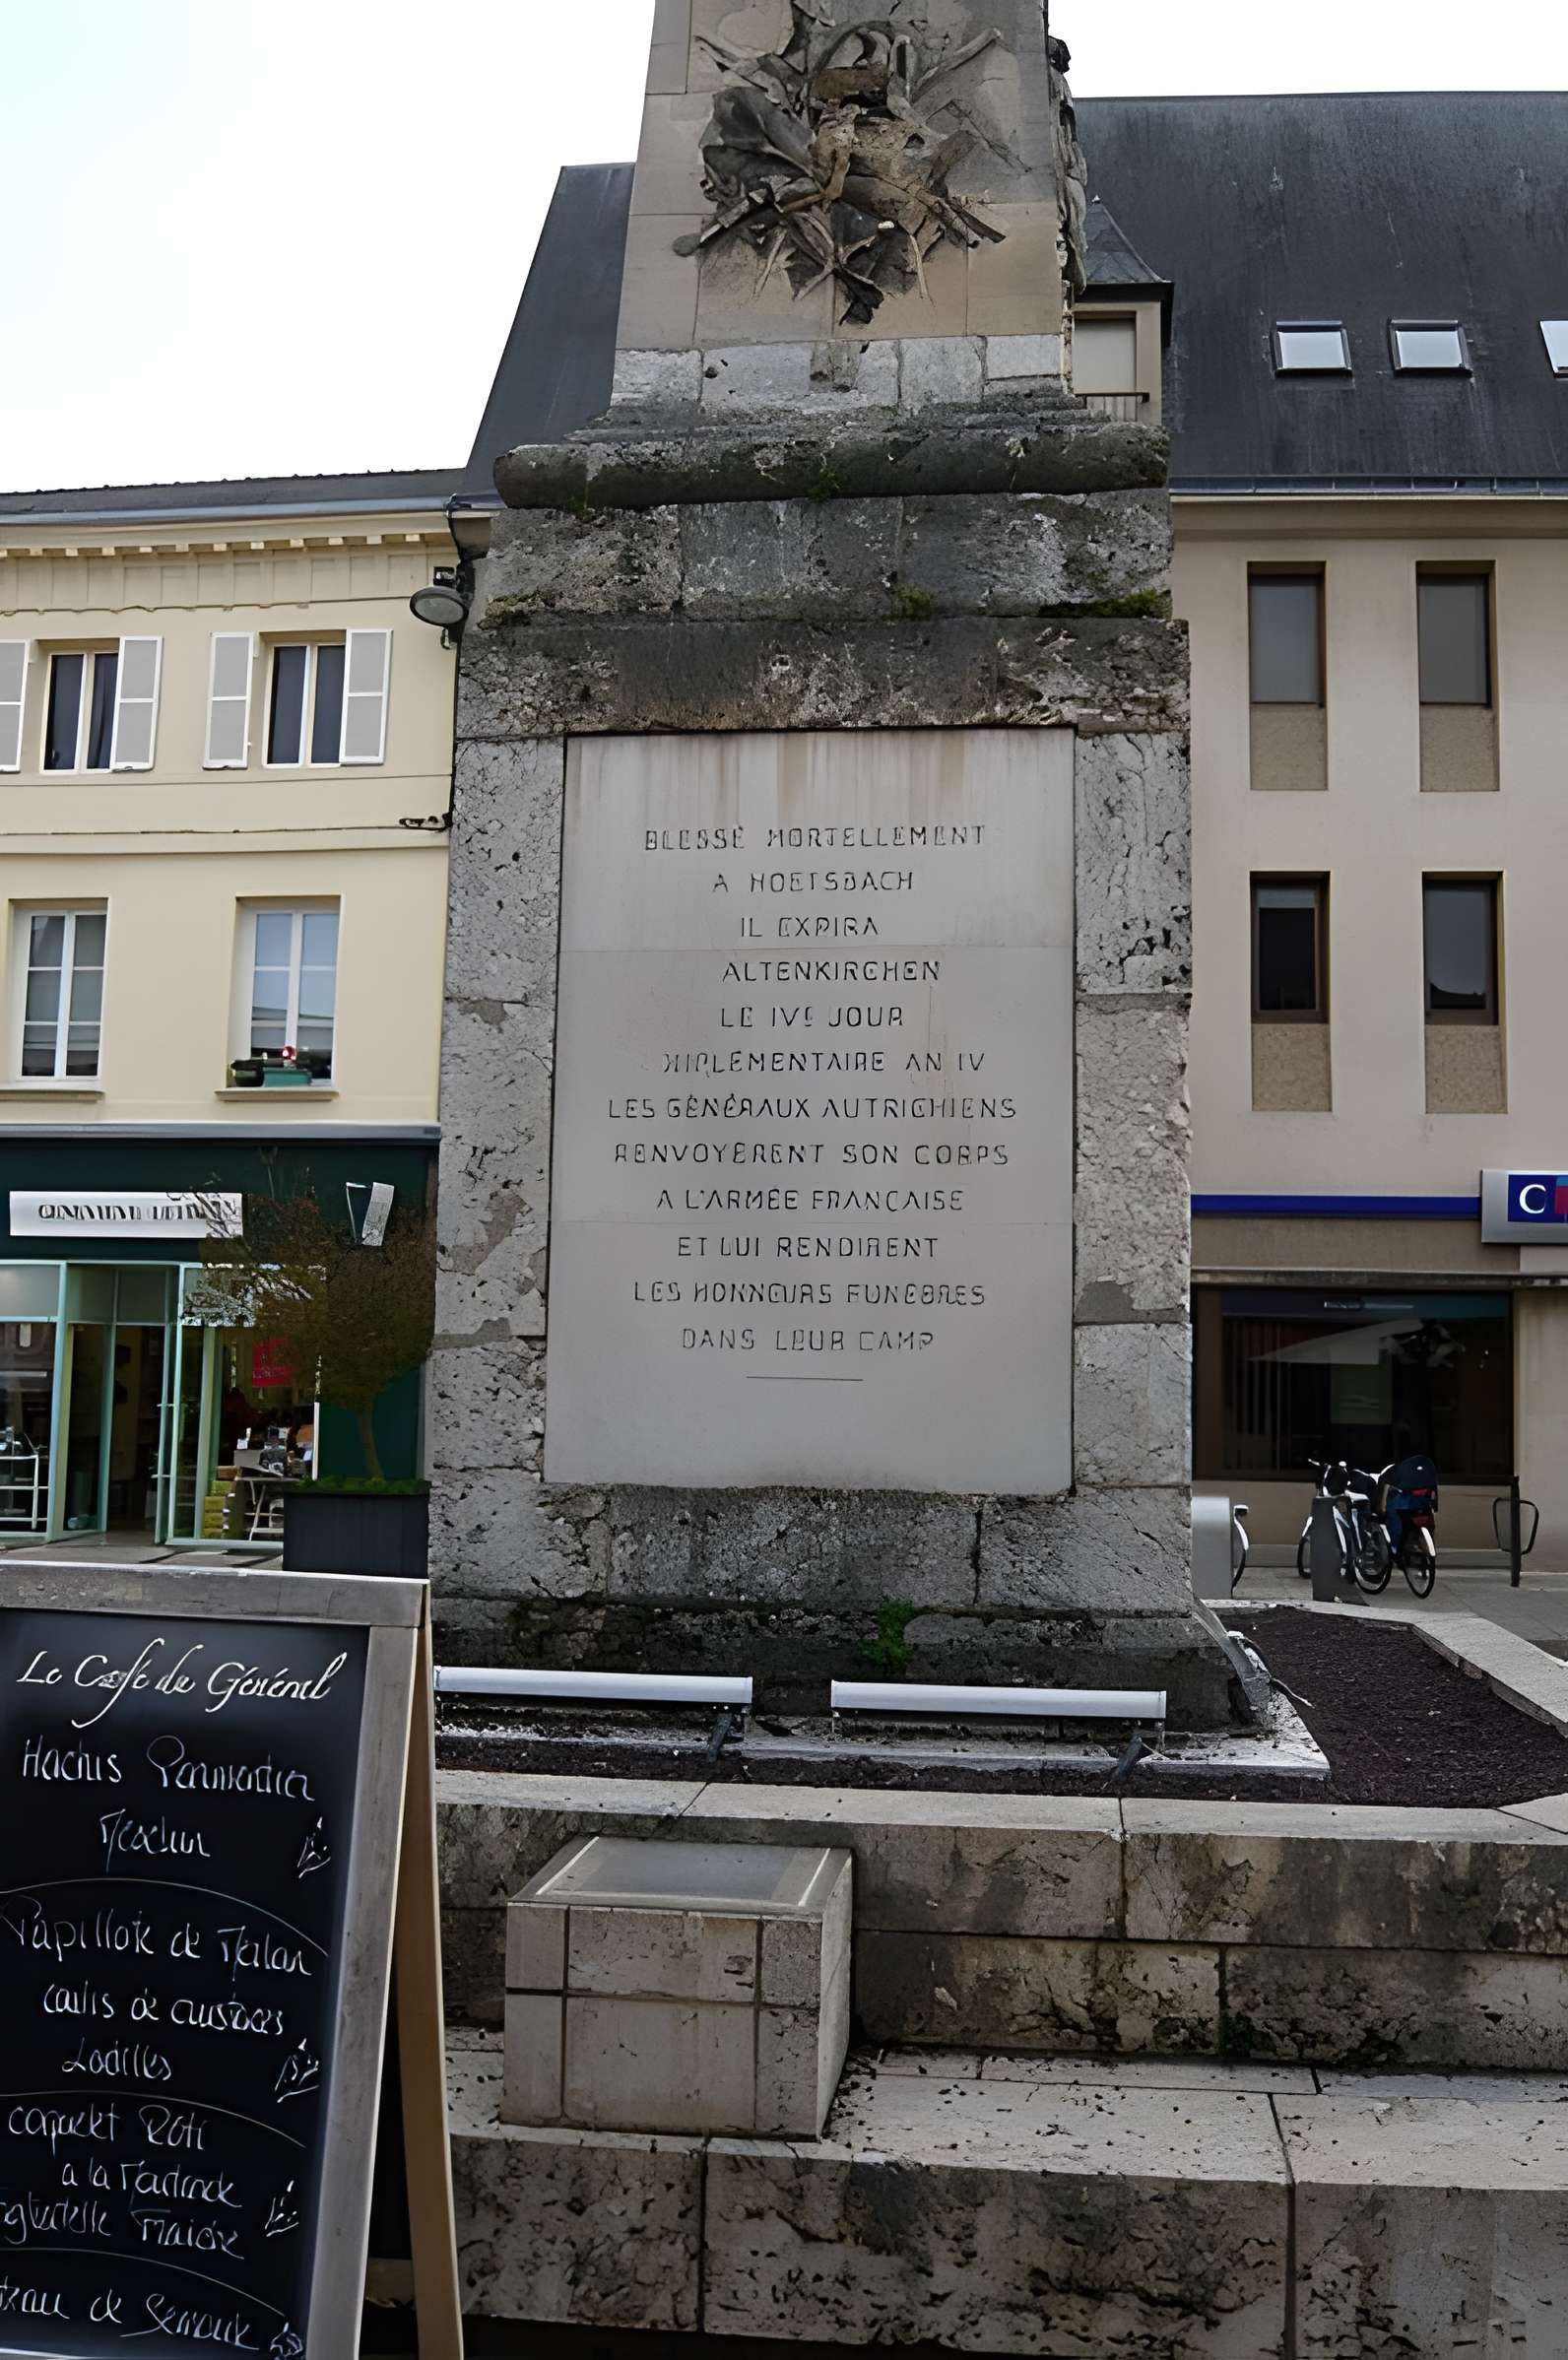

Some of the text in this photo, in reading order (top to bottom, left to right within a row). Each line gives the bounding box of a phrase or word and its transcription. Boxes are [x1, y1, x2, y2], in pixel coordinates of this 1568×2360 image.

[712, 874, 729, 893] A
[741, 916, 879, 938] IL EXPIRA
[722, 960, 941, 983] ALTENKIRCHEN
[720, 1006, 753, 1028] LE
[827, 1006, 903, 1028] JOUR
[905, 1052, 942, 1073] AN
[958, 1052, 985, 1072] IV
[609, 1098, 656, 1119] LES
[821, 1097, 1016, 1119] AUTRICHIENS
[842, 1144, 898, 1165] SON
[914, 1144, 1009, 1166] CORPS
[656, 1189, 674, 1211] A
[678, 1236, 939, 1258] ET LUI RENDIRENT
[634, 1280, 682, 1303] LES
[693, 1281, 832, 1304] HONNEURS
[682, 1328, 934, 1351] DANS LEUR CAMP
